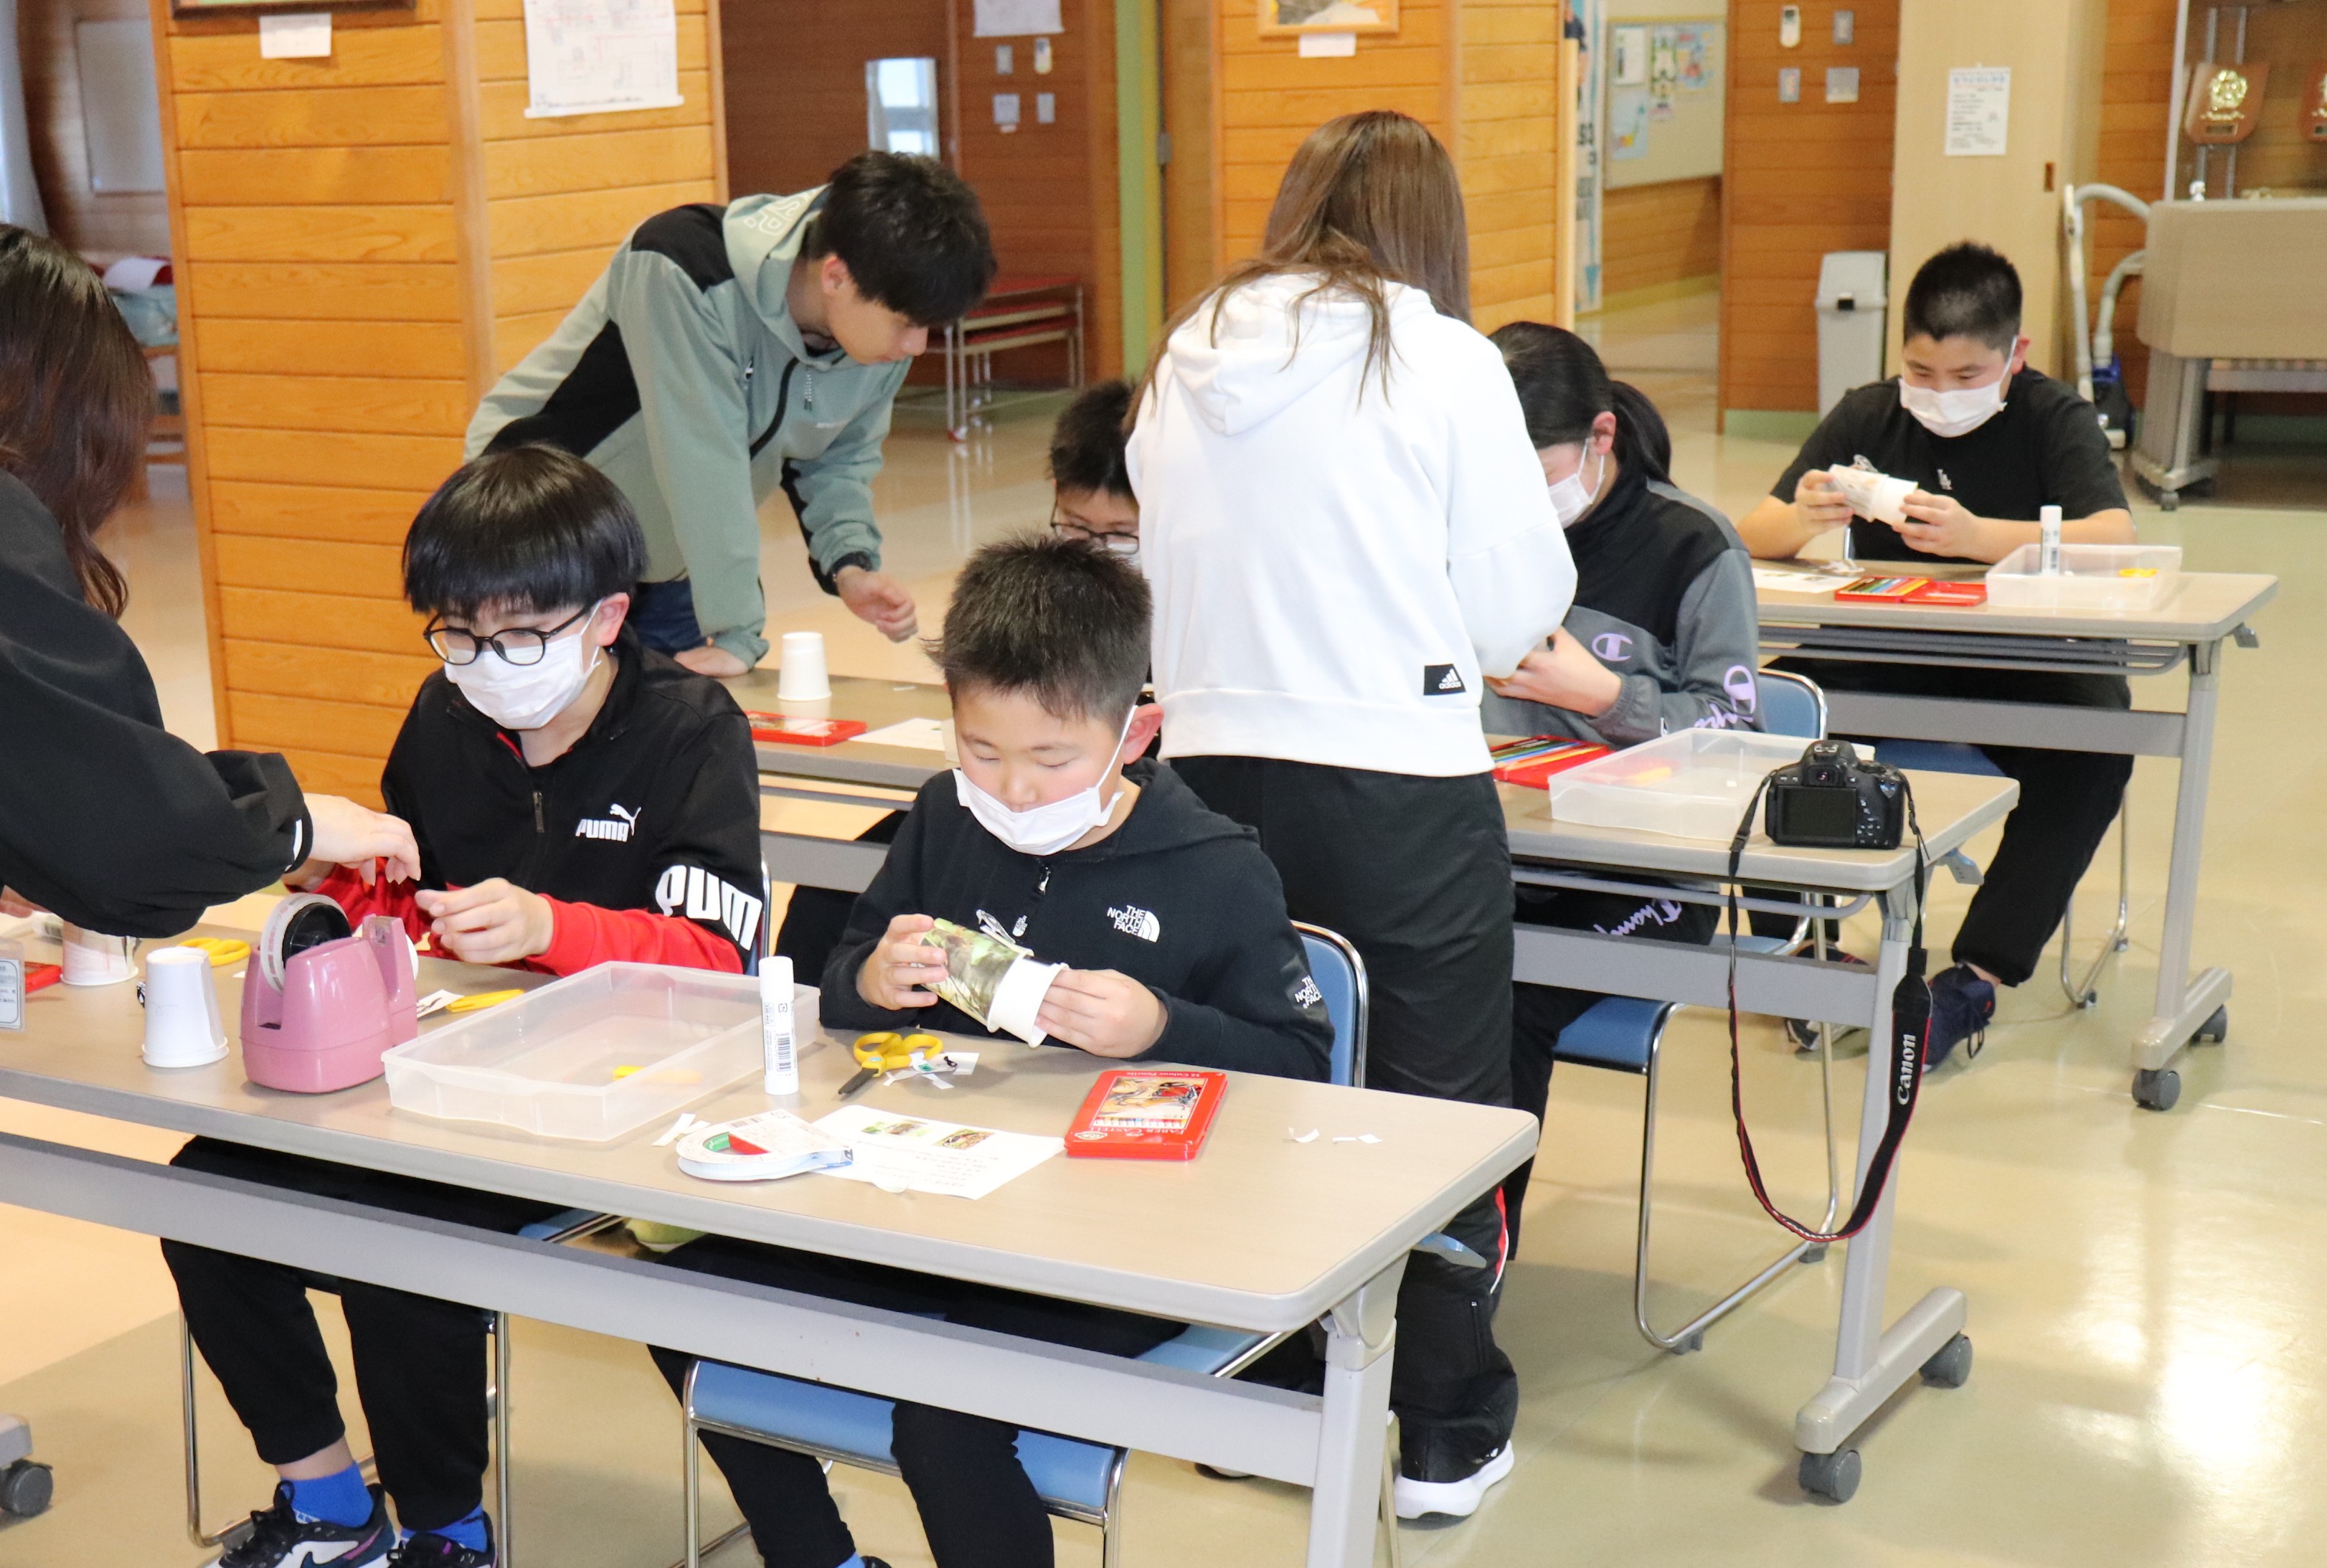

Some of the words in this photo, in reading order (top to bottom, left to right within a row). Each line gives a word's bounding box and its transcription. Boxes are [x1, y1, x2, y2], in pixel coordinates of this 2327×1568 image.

[575, 818, 630, 842] PUMA
[1107, 907, 1143, 929] NORTH
[1126, 905, 1146, 919] THE
[1113, 919, 1139, 936] FACE
[1301, 975, 1313, 987] TH
[1305, 991, 1322, 1006] FAC
[1897, 1034, 1916, 1105] Canon
[1146, 1126, 1185, 1135] FABER
